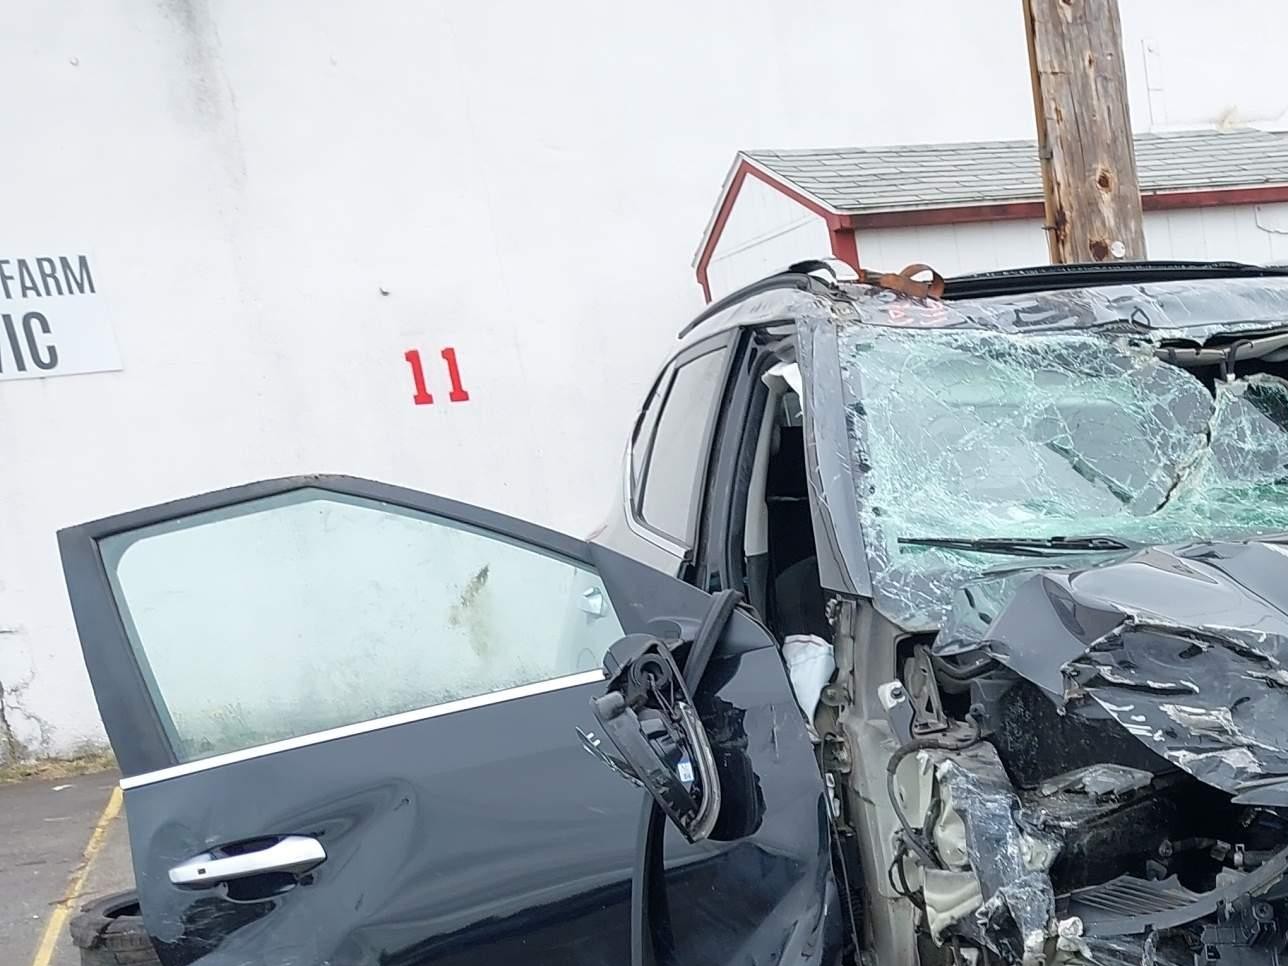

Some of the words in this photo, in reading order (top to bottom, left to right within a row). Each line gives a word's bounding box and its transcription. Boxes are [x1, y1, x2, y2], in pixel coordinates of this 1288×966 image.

[0, 255, 96, 299] FARM
[0, 311, 59, 374] IC
[403, 347, 471, 407] 11
